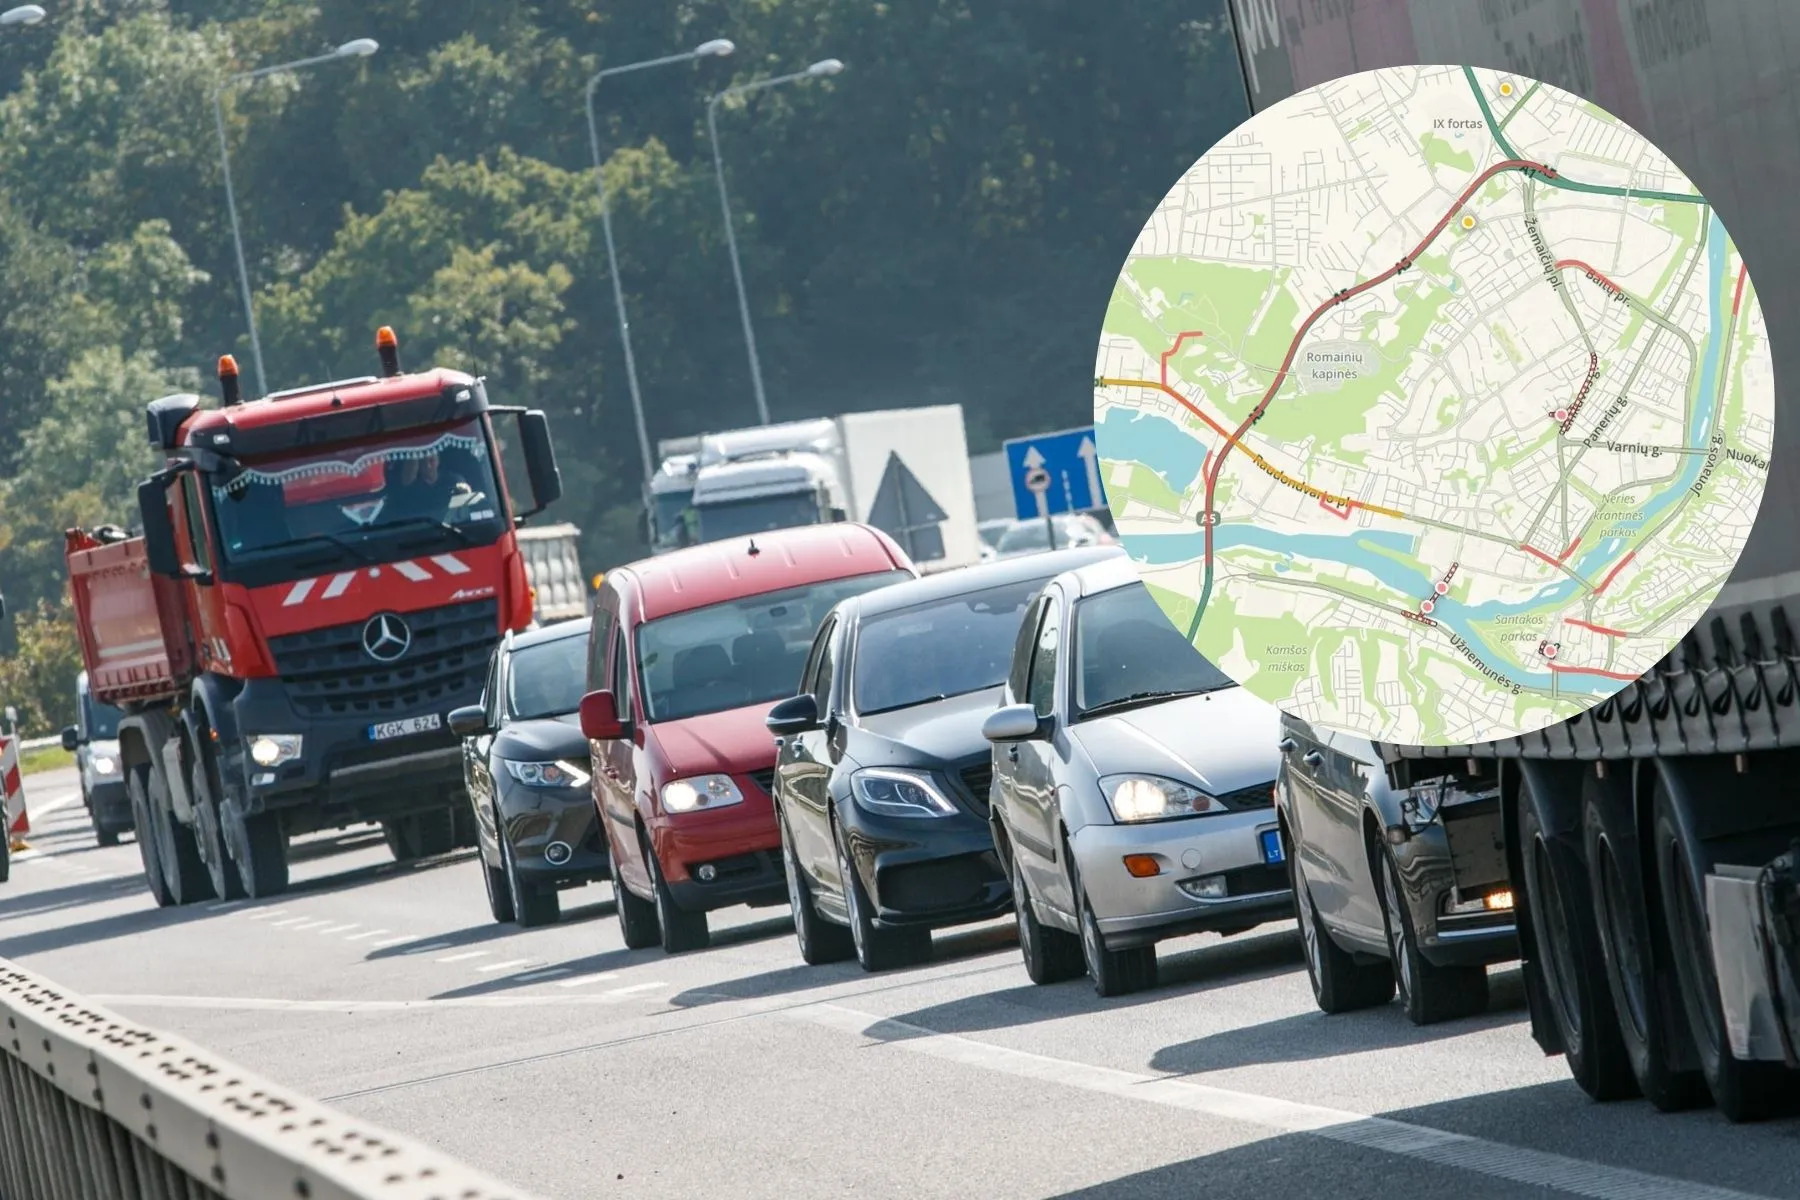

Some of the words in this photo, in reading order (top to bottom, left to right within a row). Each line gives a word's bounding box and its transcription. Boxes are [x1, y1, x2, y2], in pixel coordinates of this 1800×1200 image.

[376, 721, 405, 738] KGK
[413, 715, 438, 731] 624
[1267, 849, 1279, 859] LT
